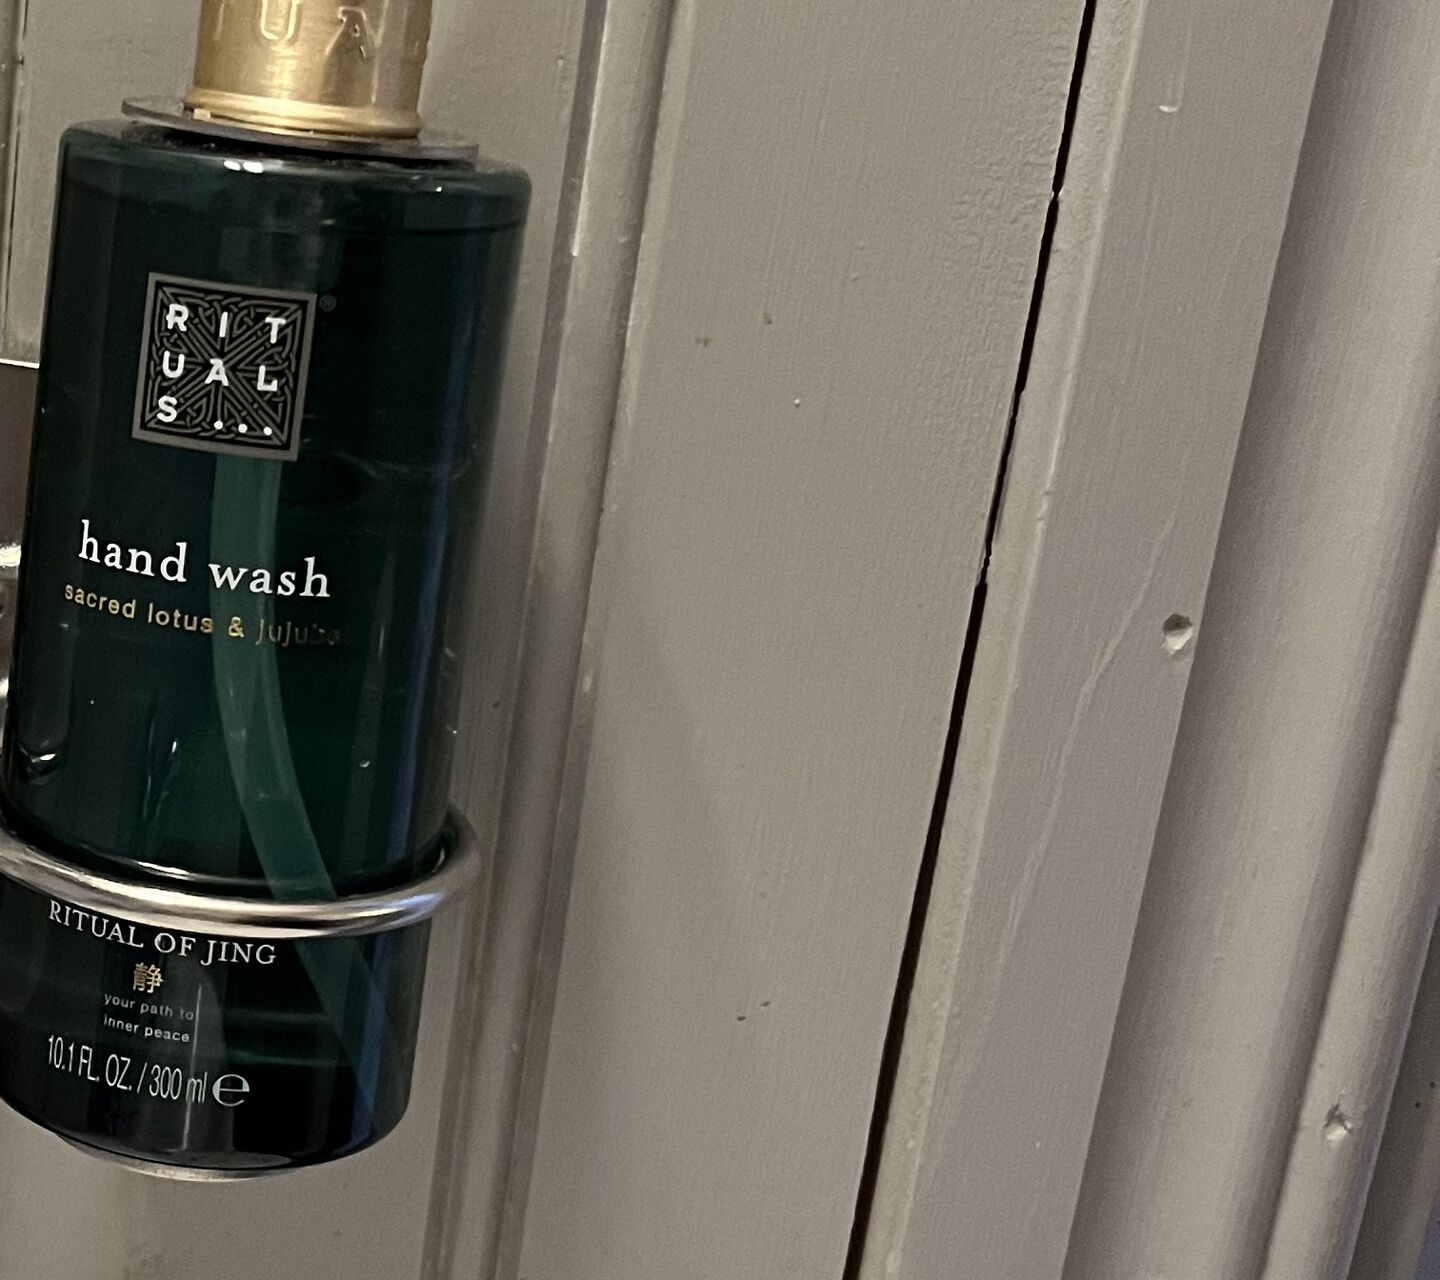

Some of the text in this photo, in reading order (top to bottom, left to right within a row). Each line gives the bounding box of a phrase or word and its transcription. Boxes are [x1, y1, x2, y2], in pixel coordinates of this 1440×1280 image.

[78, 519, 331, 598] hand wash
[64, 583, 137, 619] sacred
[147, 602, 213, 634] lotus
[228, 616, 245, 638] &
[48, 899, 277, 967] RITUAL OF JING
[104, 992, 194, 1021] your path to
[104, 1015, 190, 1044] inner peace
[48, 1035, 75, 1073] 10.1
[105, 1054, 133, 1091] OZ.
[137, 1062, 148, 1094] /
[149, 1064, 183, 1101] 300
[185, 1071, 208, 1104] ml
